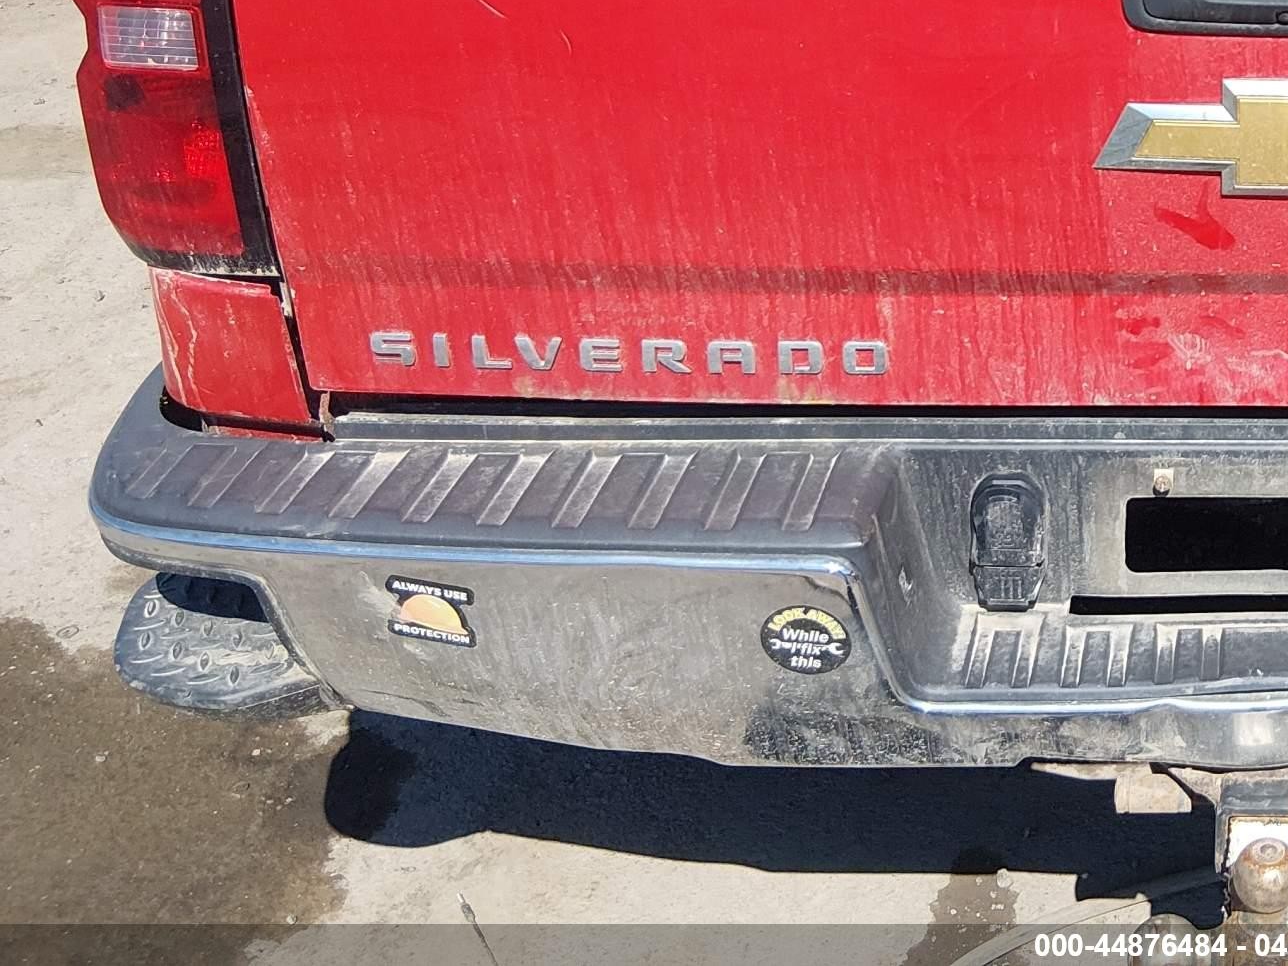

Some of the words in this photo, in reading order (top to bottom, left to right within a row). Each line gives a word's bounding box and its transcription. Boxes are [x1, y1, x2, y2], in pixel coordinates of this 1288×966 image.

[370, 331, 889, 376] SILVERADO
[391, 580, 442, 596] ALWAYS
[443, 589, 468, 601] USE
[767, 607, 806, 631] LOOK
[393, 623, 470, 644] PROTECTION
[782, 627, 830, 644] While
[800, 642, 822, 655] fix
[790, 655, 822, 669] this
